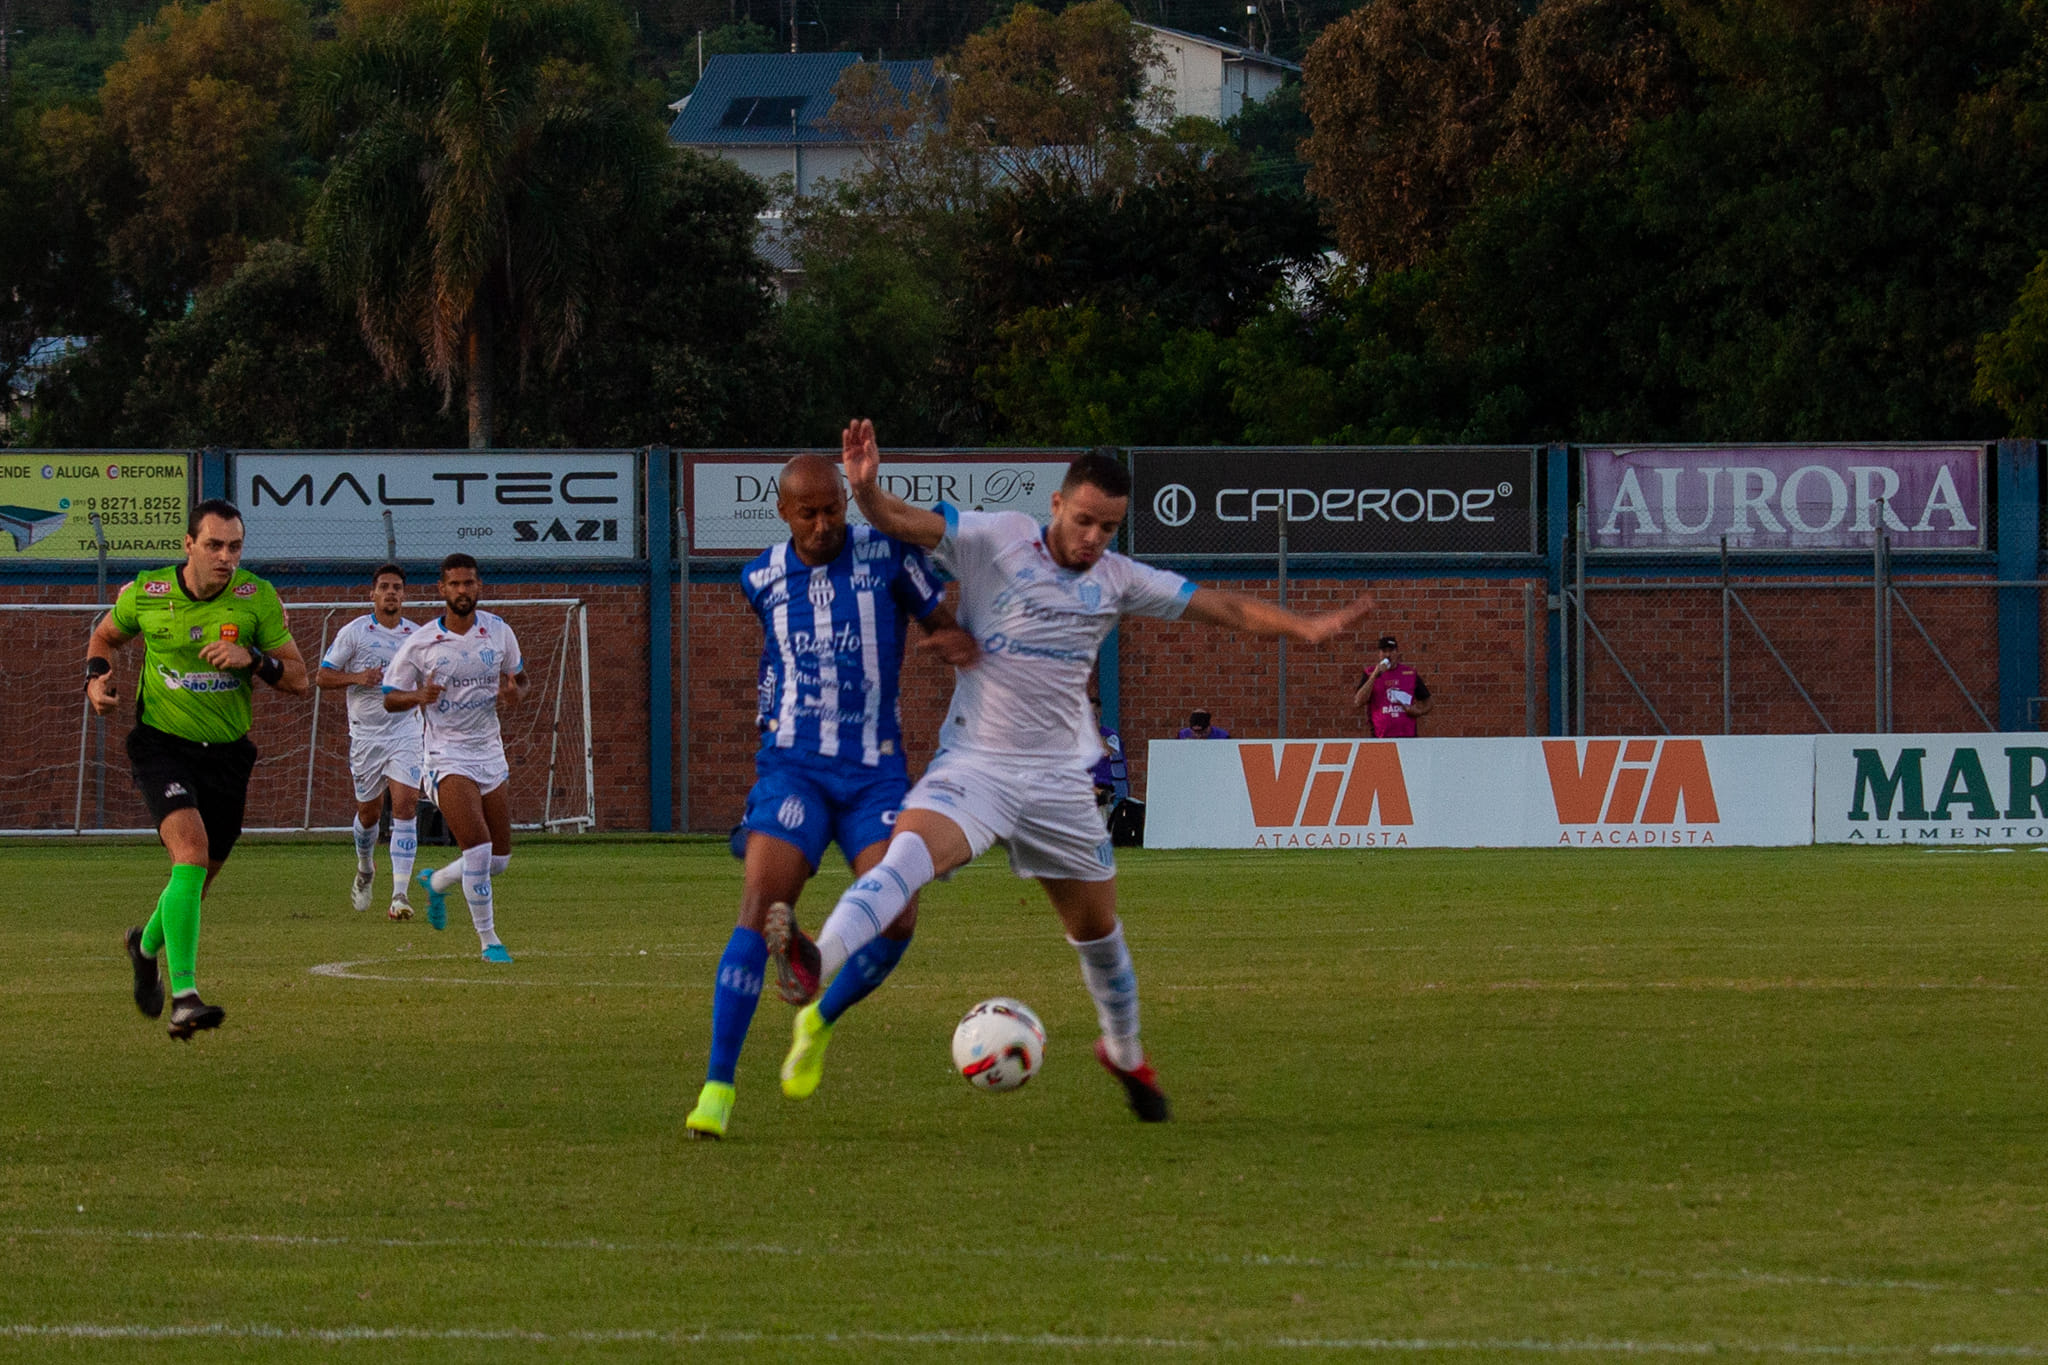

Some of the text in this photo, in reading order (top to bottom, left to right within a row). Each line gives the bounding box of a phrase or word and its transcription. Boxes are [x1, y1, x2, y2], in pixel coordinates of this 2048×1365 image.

[56, 466, 100, 479] ALUGA
[121, 466, 184, 479] REFORMA
[252, 473, 618, 506] MALTEC
[87, 498, 97, 510] 9
[100, 498, 181, 510] 8271.8252
[1597, 465, 1977, 535] AURORA
[101, 512, 182, 525] 9533.5175
[457, 519, 618, 542] grupo SAZI
[78, 540, 182, 551] TAQUARA/RS
[1848, 747, 2048, 821] MAR
[1255, 832, 1408, 847] ATACADISTA
[1559, 830, 1714, 844] ATACADISTA
